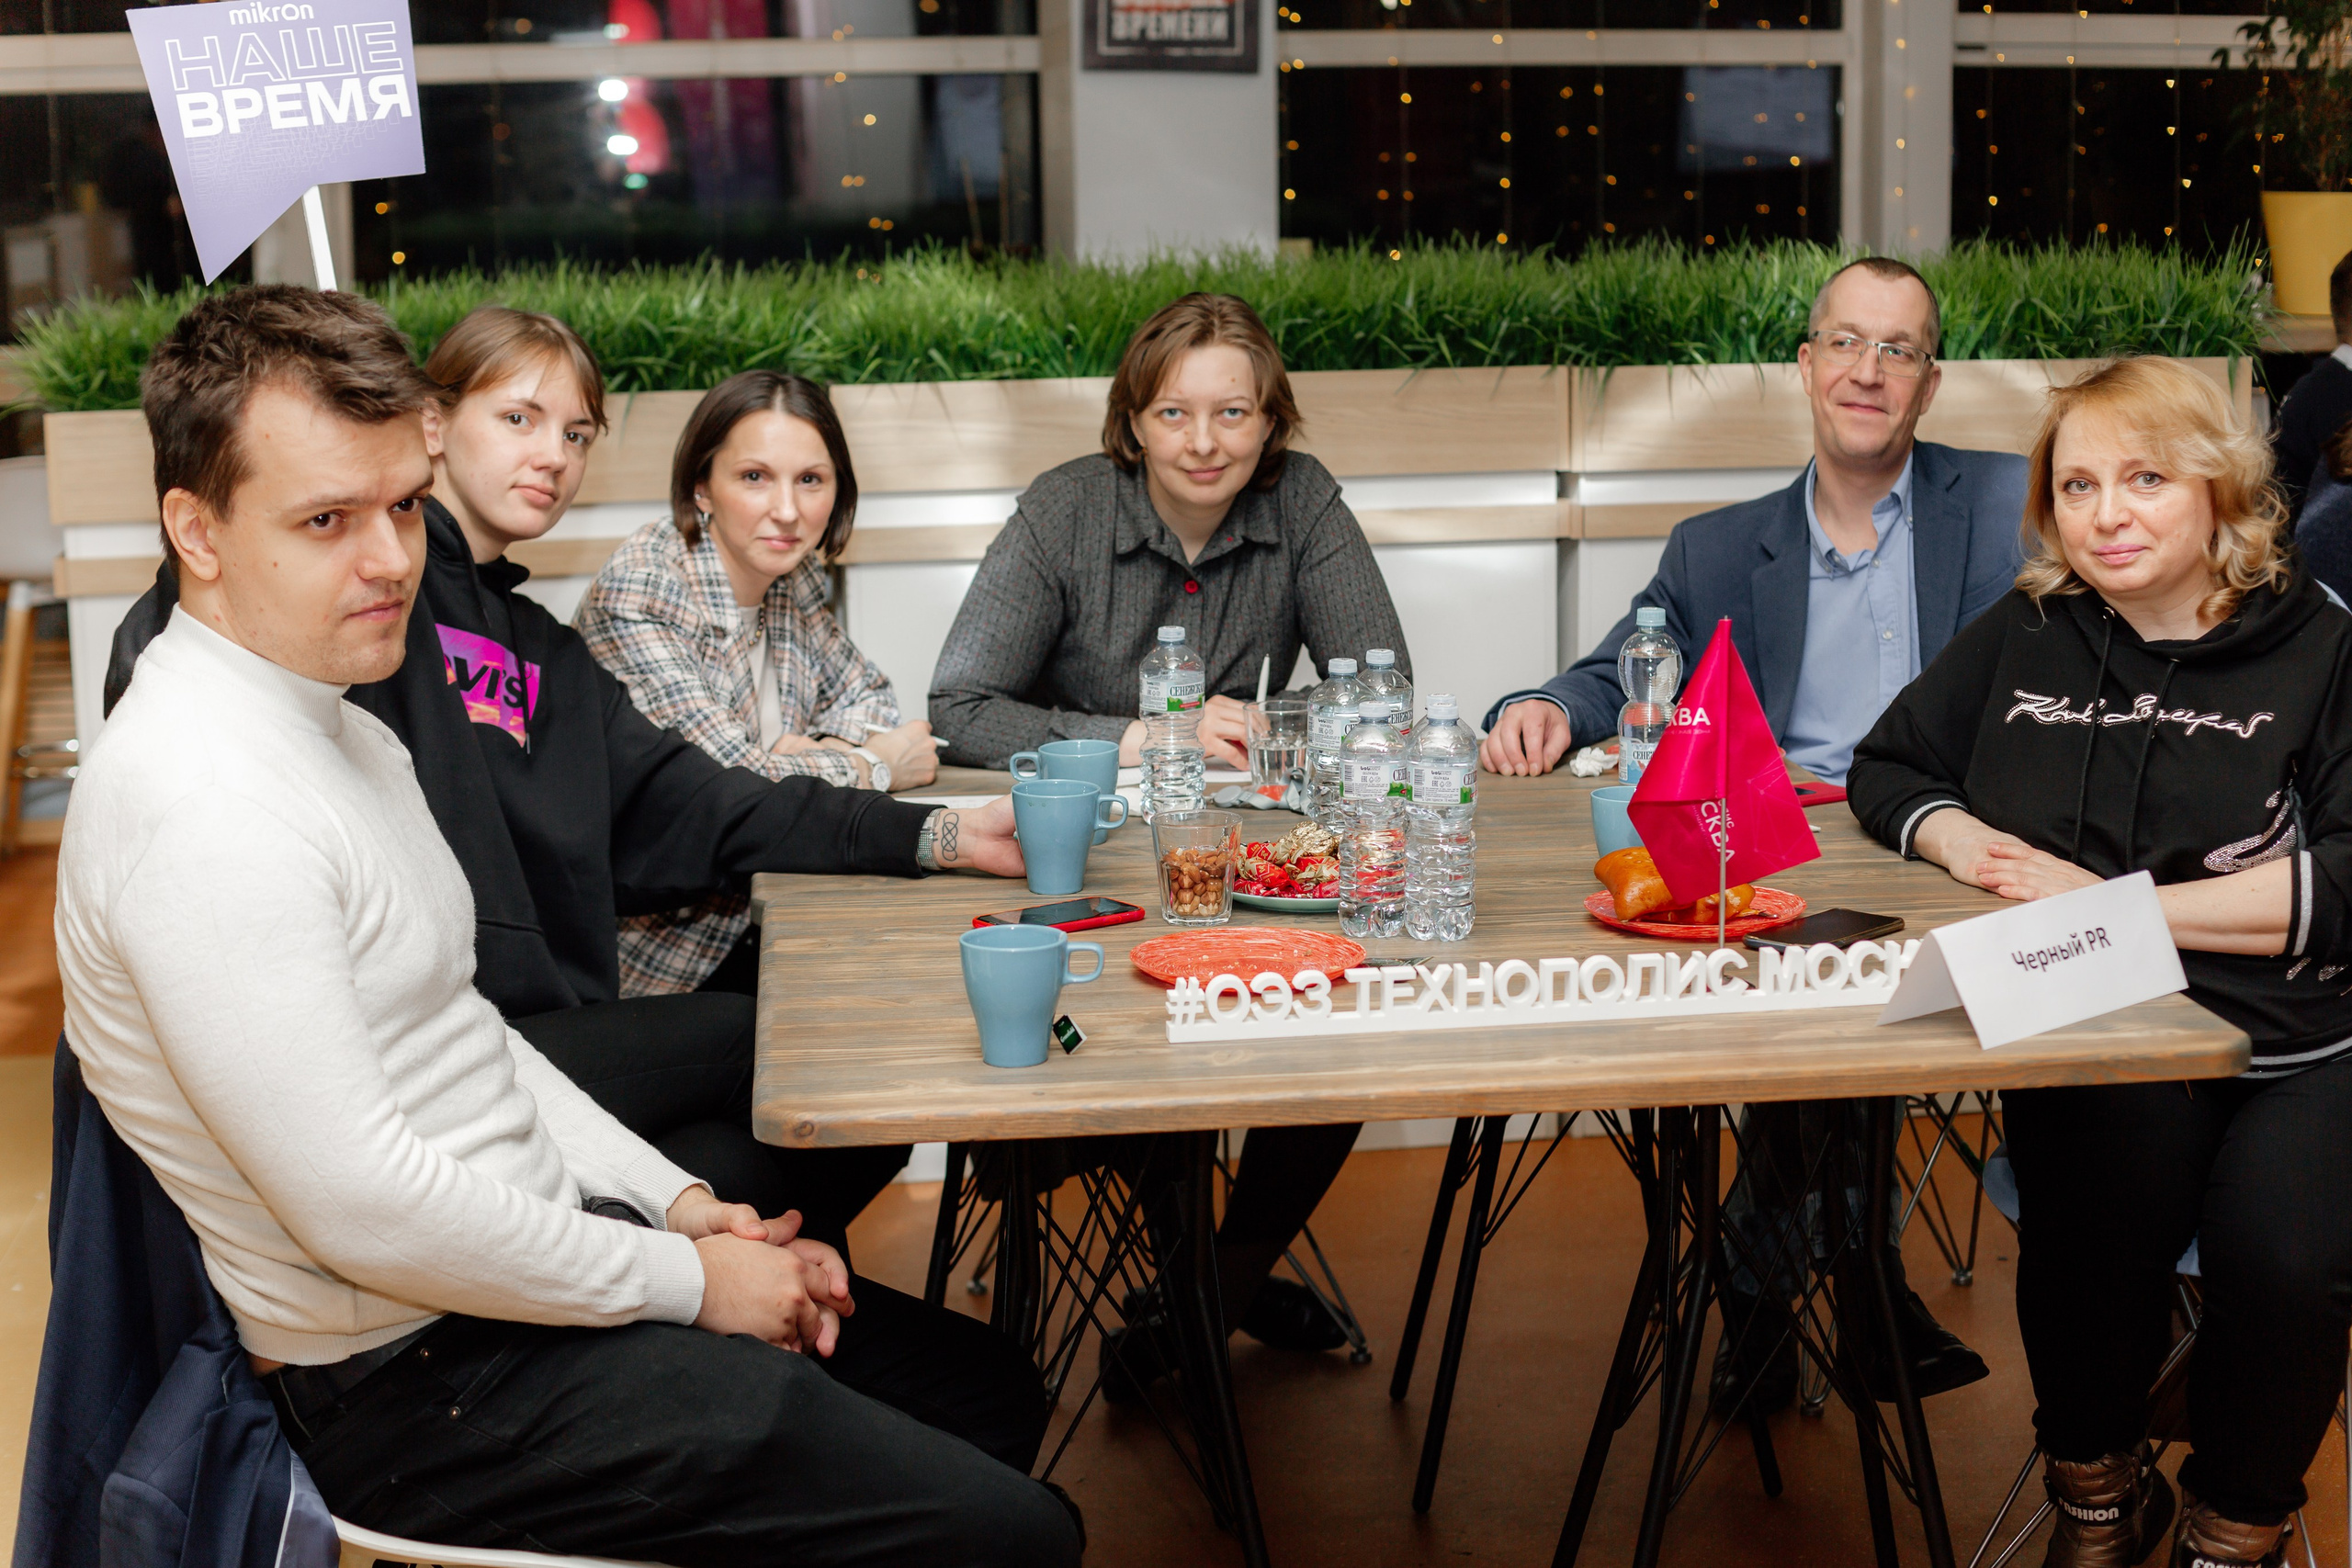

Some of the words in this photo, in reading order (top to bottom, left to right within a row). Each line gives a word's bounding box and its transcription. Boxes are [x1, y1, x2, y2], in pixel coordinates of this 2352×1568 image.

[229, 2, 314, 26] mikron
[164, 20, 404, 91] НАШЕ
[175, 73, 413, 139] ВРЕМЯ
[2011, 932, 2086, 972] Черный
[2085, 927, 2112, 952] PR
